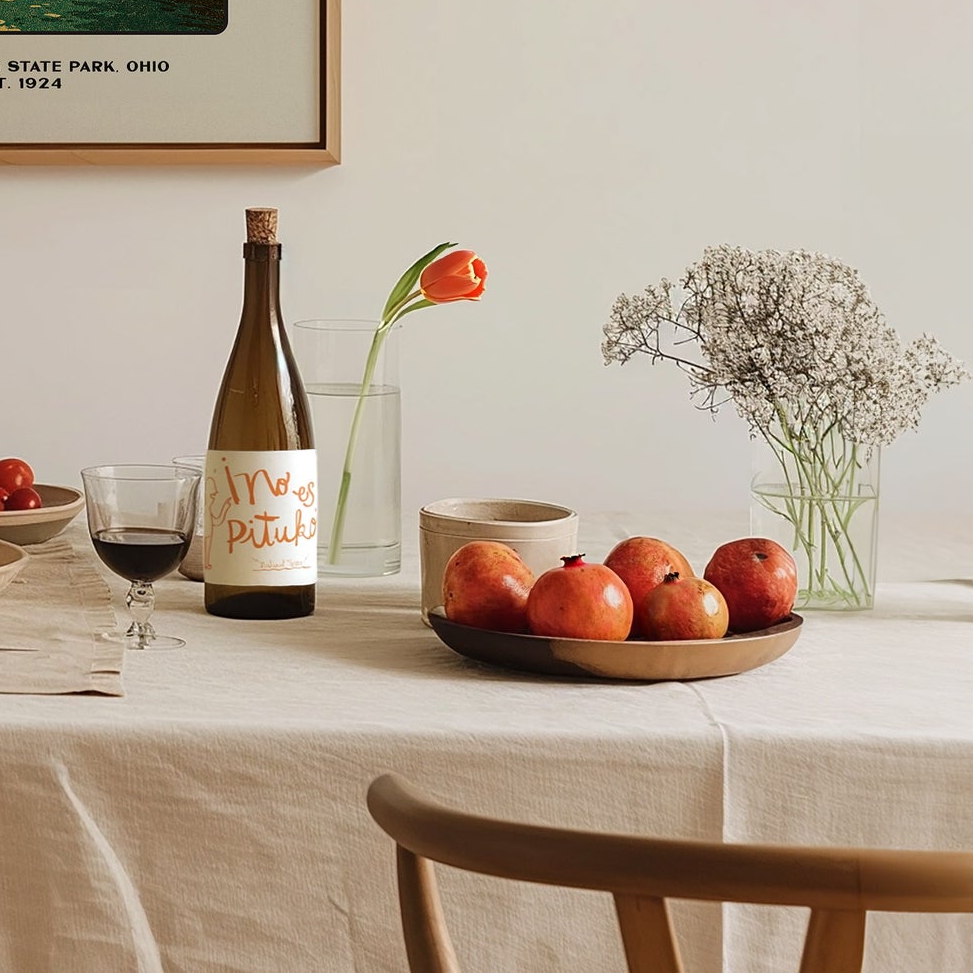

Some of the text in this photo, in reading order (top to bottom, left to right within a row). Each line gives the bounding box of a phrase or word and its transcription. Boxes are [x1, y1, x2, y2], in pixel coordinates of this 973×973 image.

[7, 60, 62, 73] STATE
[126, 60, 170, 73] OHIO
[18, 77, 62, 89] 1924
